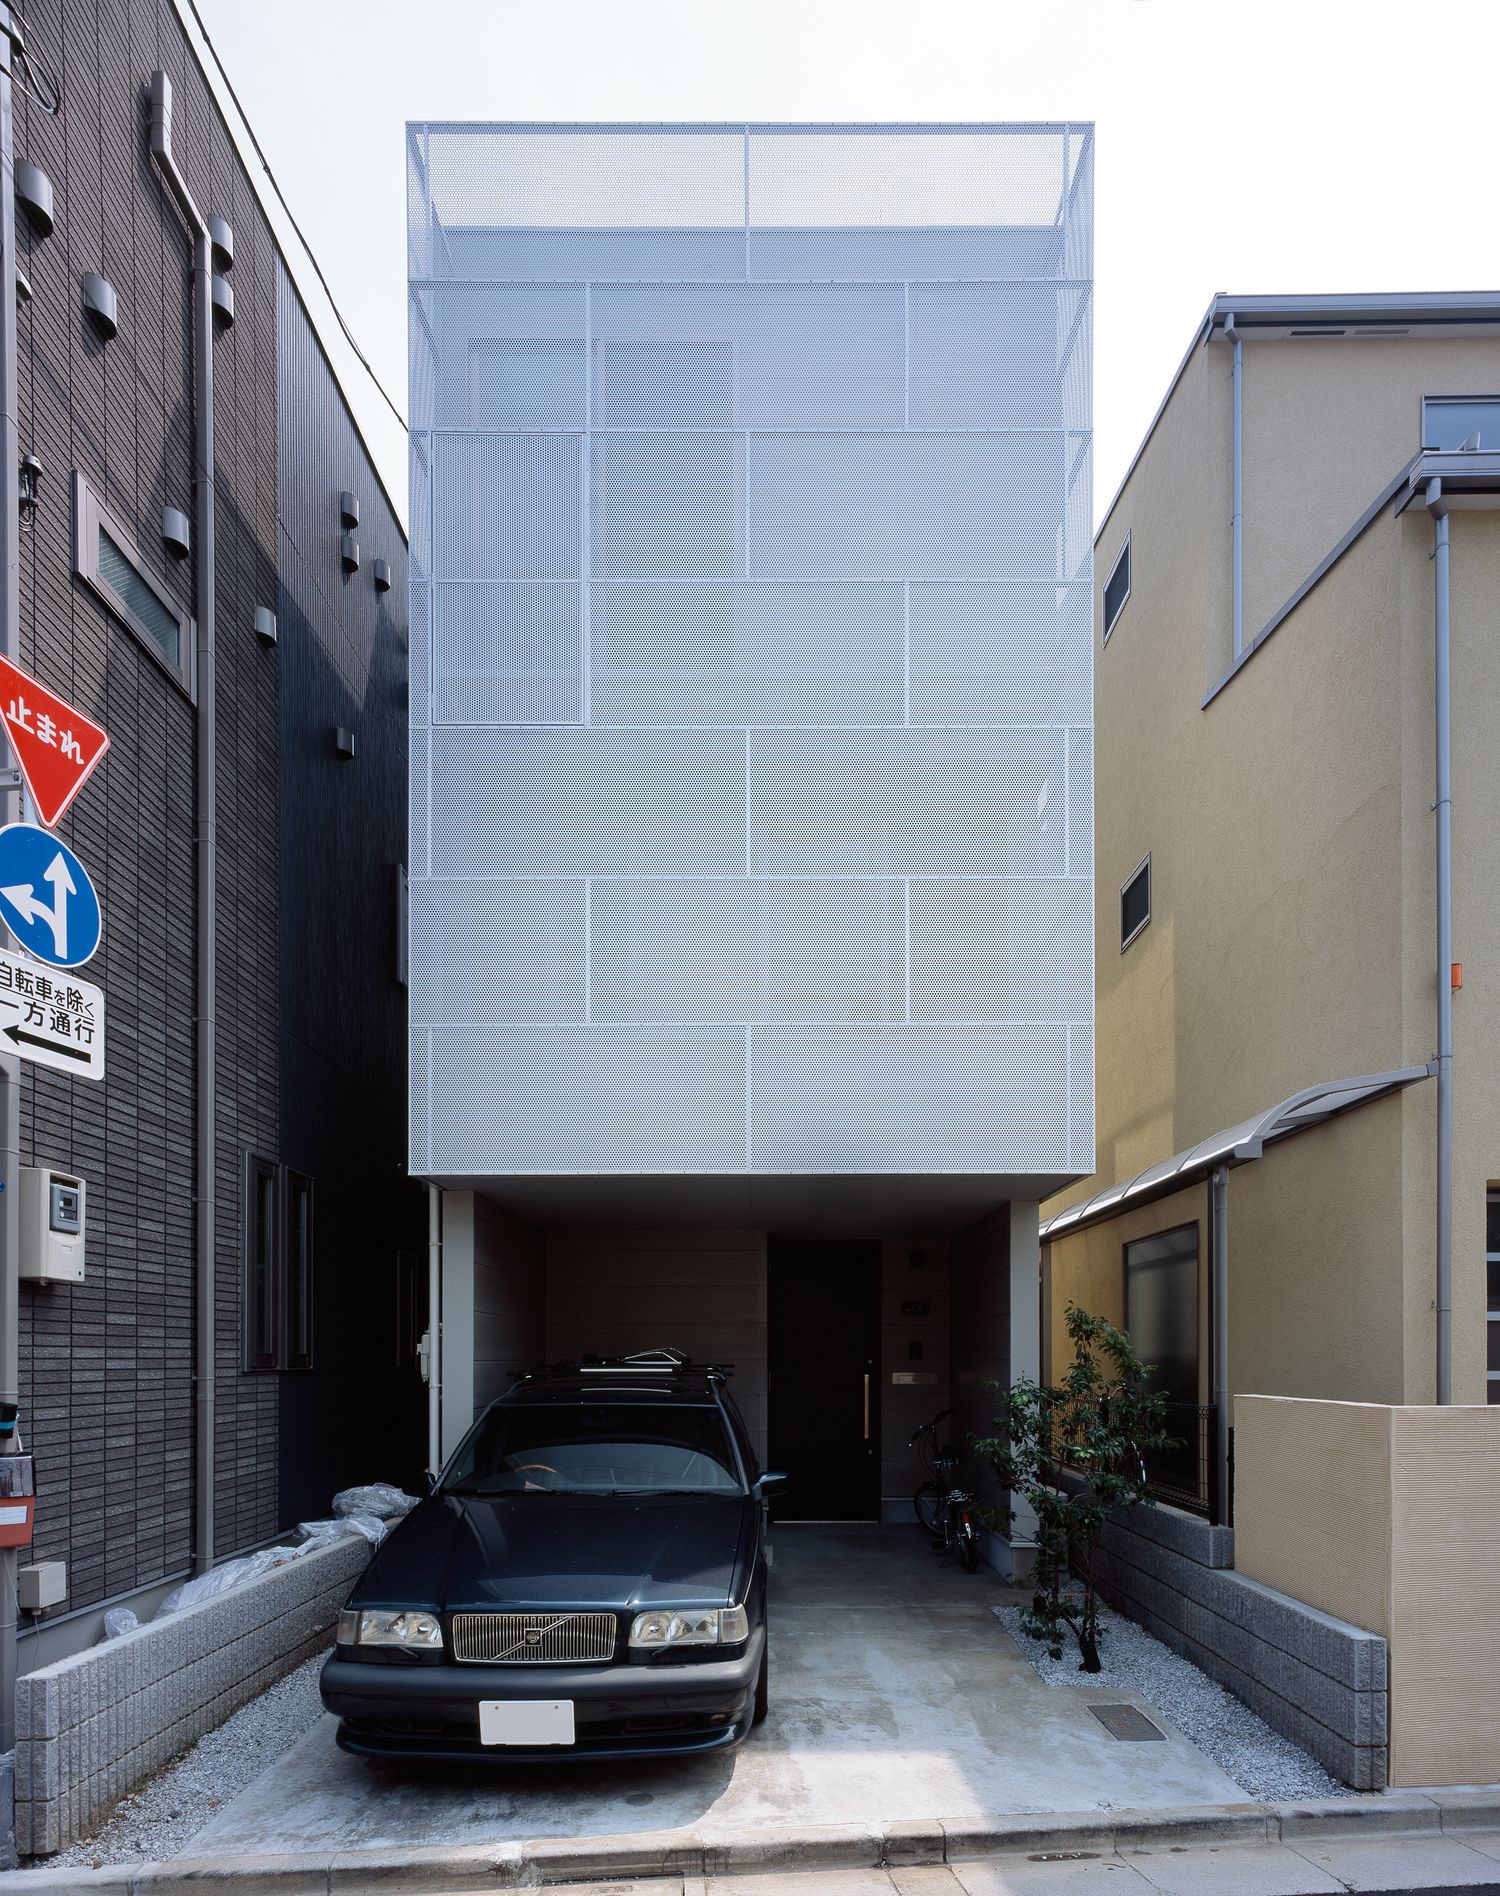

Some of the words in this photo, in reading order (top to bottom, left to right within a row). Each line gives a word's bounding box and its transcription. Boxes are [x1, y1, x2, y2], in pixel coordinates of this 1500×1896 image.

[6, 696, 85, 765] 止まれ
[0, 960, 94, 1018] 自転車を除く
[0, 1000, 95, 1044] 一方通行
